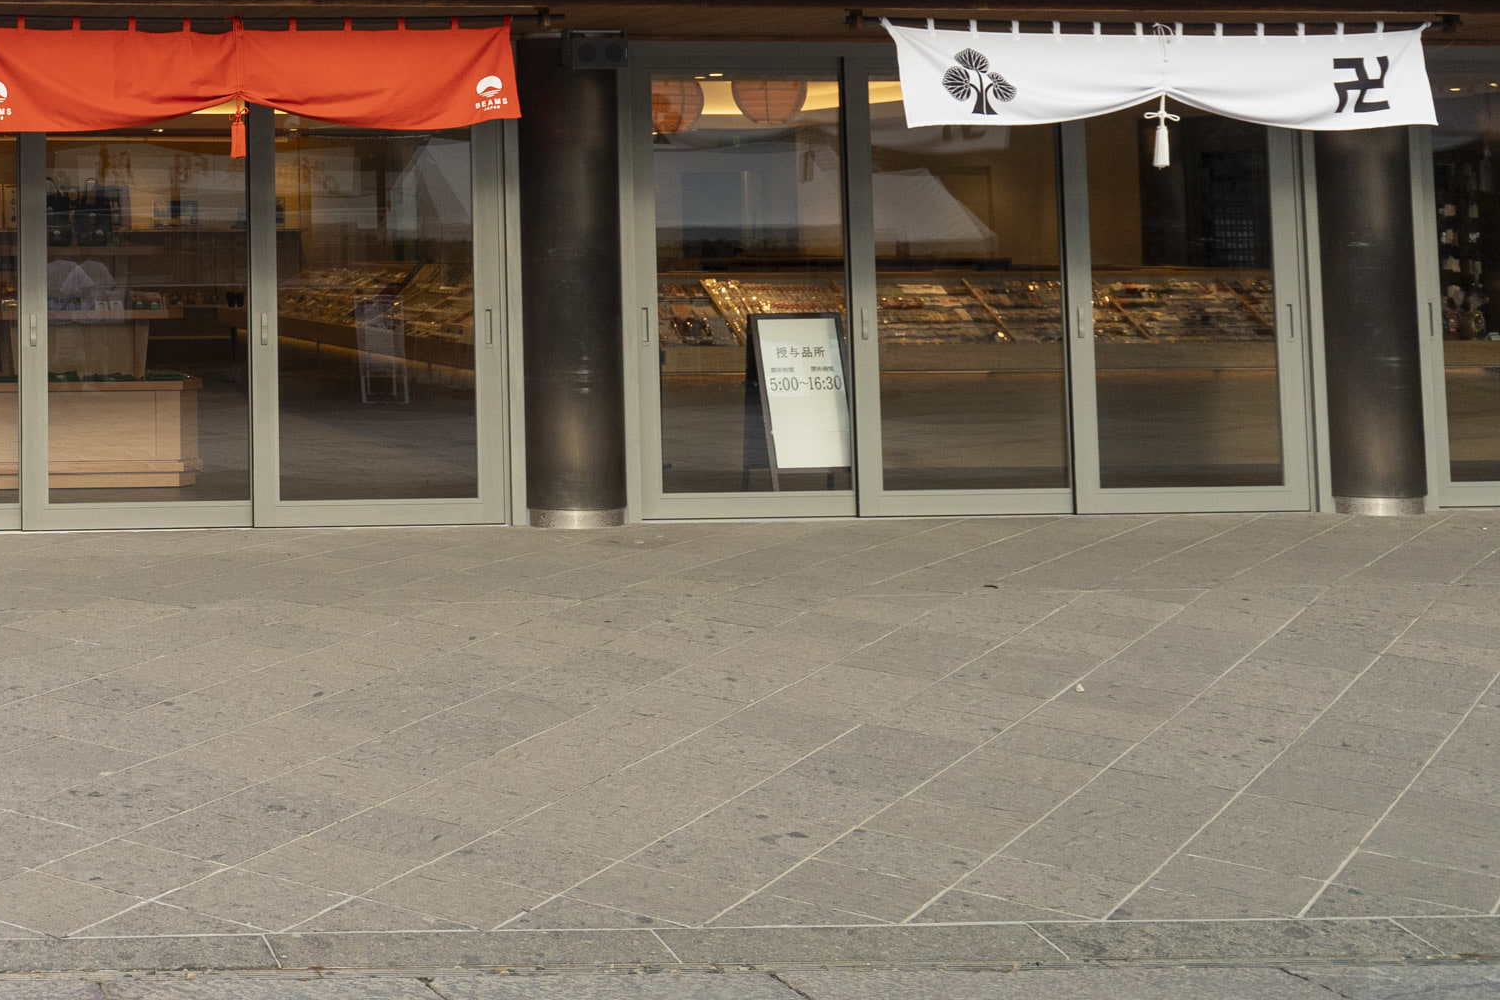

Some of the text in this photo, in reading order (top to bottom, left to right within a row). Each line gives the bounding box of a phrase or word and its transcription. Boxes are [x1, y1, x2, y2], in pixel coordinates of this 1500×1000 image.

[475, 97, 508, 109] BEAMS
[775, 346, 825, 358] 授与品所
